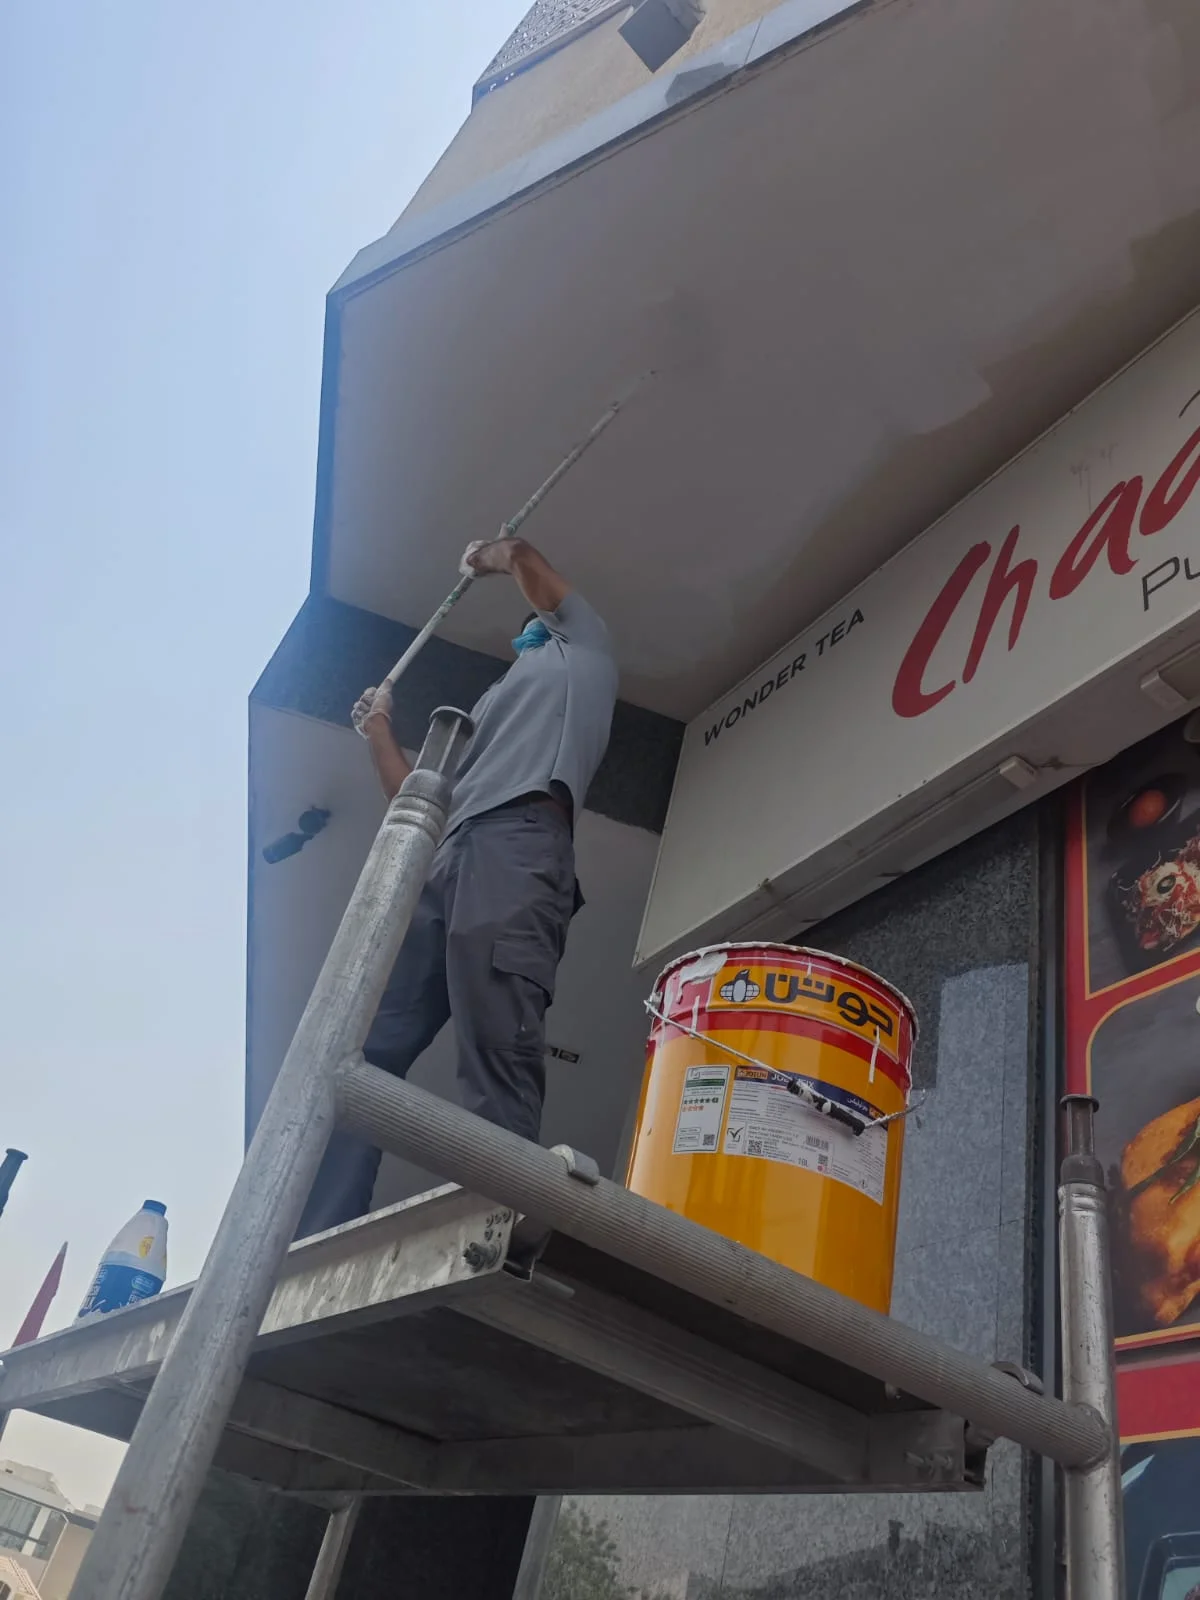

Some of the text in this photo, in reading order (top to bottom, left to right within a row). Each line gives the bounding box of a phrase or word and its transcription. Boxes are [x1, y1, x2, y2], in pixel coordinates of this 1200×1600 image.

[704, 608, 865, 746] WONDER TEA
[764, 972, 894, 1038] جوتن
